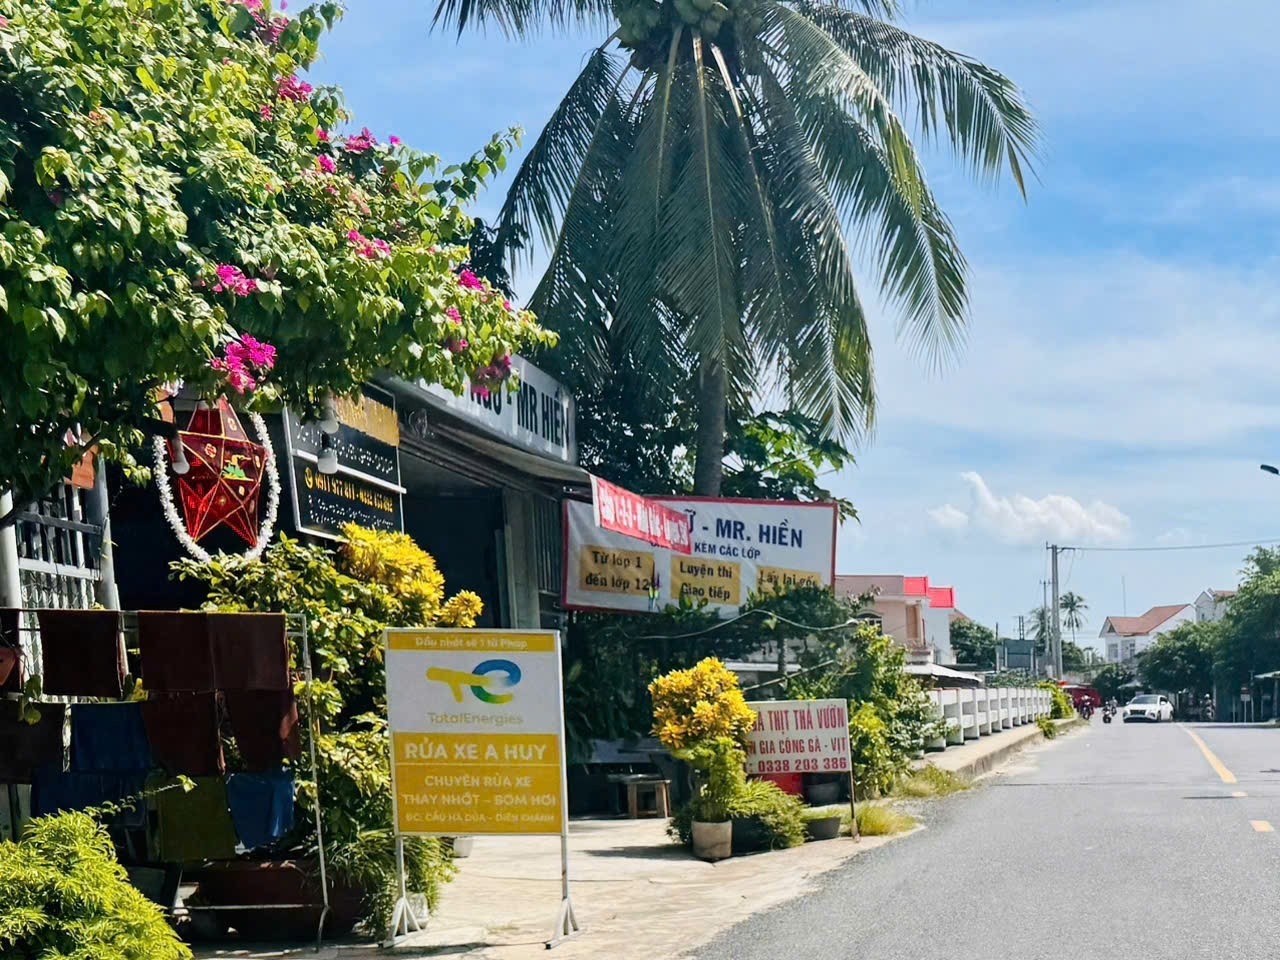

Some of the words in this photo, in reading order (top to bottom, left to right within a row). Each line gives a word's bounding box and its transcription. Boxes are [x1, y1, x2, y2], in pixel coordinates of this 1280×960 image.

[716, 518, 751, 542] MR.
[758, 519, 803, 549] HIỀN
[634, 557, 642, 569] 1
[680, 561, 714, 579] Luyện
[717, 565, 733, 579] thi
[611, 575, 630, 591] lớp
[708, 586, 731, 601] tiếp
[427, 712, 524, 725] TotalEnergies
[767, 709, 790, 735] THỊT
[816, 704, 844, 730] VƯỜN
[454, 743, 479, 760] XE
[484, 744, 499, 760] A
[504, 744, 547, 761] HUY
[759, 740, 776, 755] GIA
[779, 737, 805, 754] CÔNG
[808, 735, 821, 753] GÀ
[831, 737, 846, 755] VỊT
[758, 759, 790, 773] 0338
[823, 756, 847, 770] 386
[515, 777, 533, 788] XE
[402, 793, 438, 806] THAY
